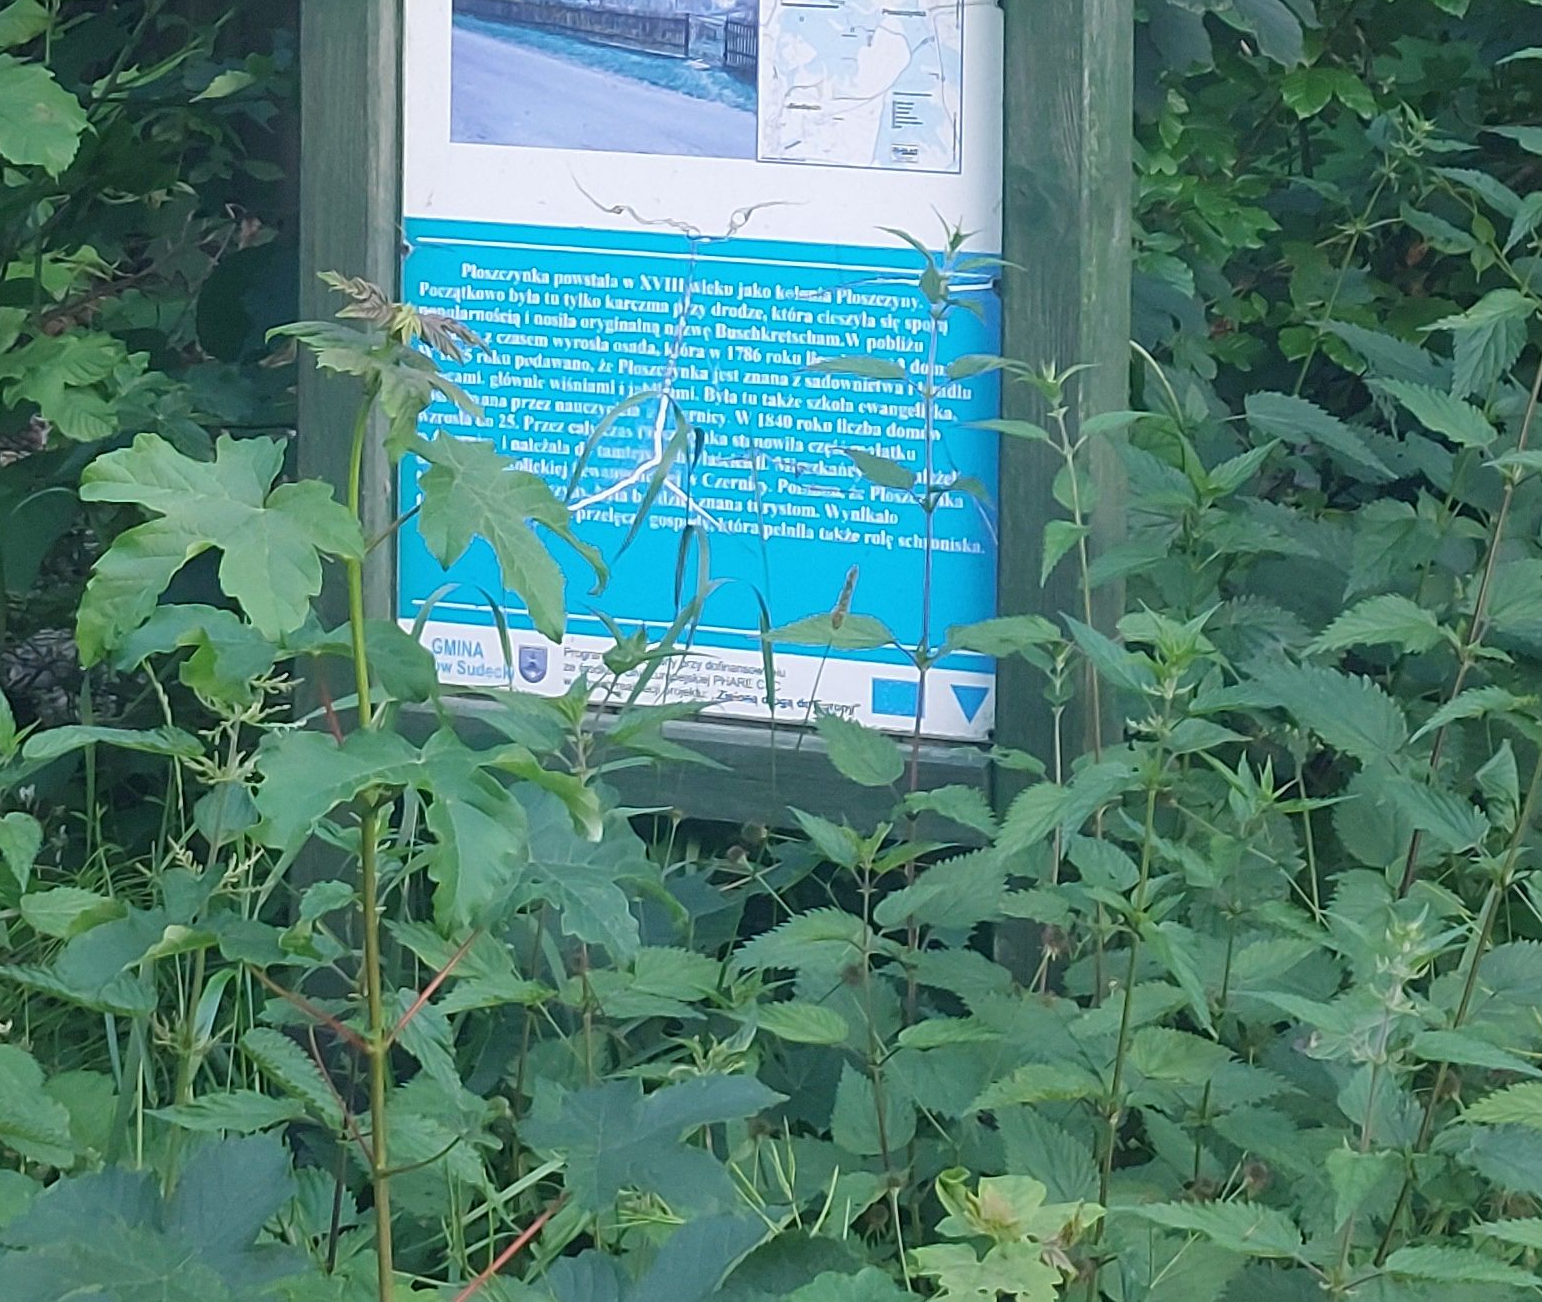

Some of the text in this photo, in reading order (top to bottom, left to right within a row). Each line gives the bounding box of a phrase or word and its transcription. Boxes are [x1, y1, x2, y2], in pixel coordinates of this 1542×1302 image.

[461, 262, 549, 285] Płoszczynka
[553, 272, 618, 288] powstała
[623, 277, 634, 289] w
[640, 274, 684, 292] XVIII
[737, 282, 771, 300] jako
[836, 288, 924, 312] Płoszczyny.
[419, 281, 505, 303] Początkowo
[509, 287, 540, 307] była
[544, 292, 559, 305] tu
[563, 293, 601, 310] tylko
[605, 294, 669, 313] karczma
[771, 306, 813, 324] która
[817, 310, 876, 329] cieszyła
[880, 315, 901, 332] się
[905, 318, 948, 337] spoą
[533, 312, 577, 329] nosiła
[580, 317, 660, 338] oryginalną
[866, 334, 924, 354] pobliżu
[496, 333, 548, 348] czasem
[552, 336, 610, 354] wyrosła
[727, 345, 763, 363] 1786
[765, 349, 802, 366] roku
[597, 358, 614, 373] że
[743, 371, 789, 386] znana
[792, 374, 801, 387] z
[490, 370, 545, 389] głównie
[550, 376, 616, 395] wiśniami
[704, 386, 738, 406] Była
[741, 391, 757, 405] tu
[762, 392, 802, 409] także
[806, 394, 854, 413] szkoła
[858, 402, 958, 422] ewangelika,
[511, 397, 551, 413] przez
[734, 409, 751, 425] W
[758, 412, 793, 430] 1840
[796, 416, 832, 432] roku
[836, 417, 882, 437] liczba
[523, 414, 565, 433] Przez
[510, 438, 570, 455] należała
[702, 472, 773, 496] Czerniy.
[825, 503, 898, 525] Wynikało
[762, 521, 815, 541] pełniła
[819, 526, 861, 544] także
[864, 530, 894, 549] rolę
[898, 534, 986, 555] schoniska.
[432, 637, 484, 658] GMINA
[756, 680, 782, 692] CC
